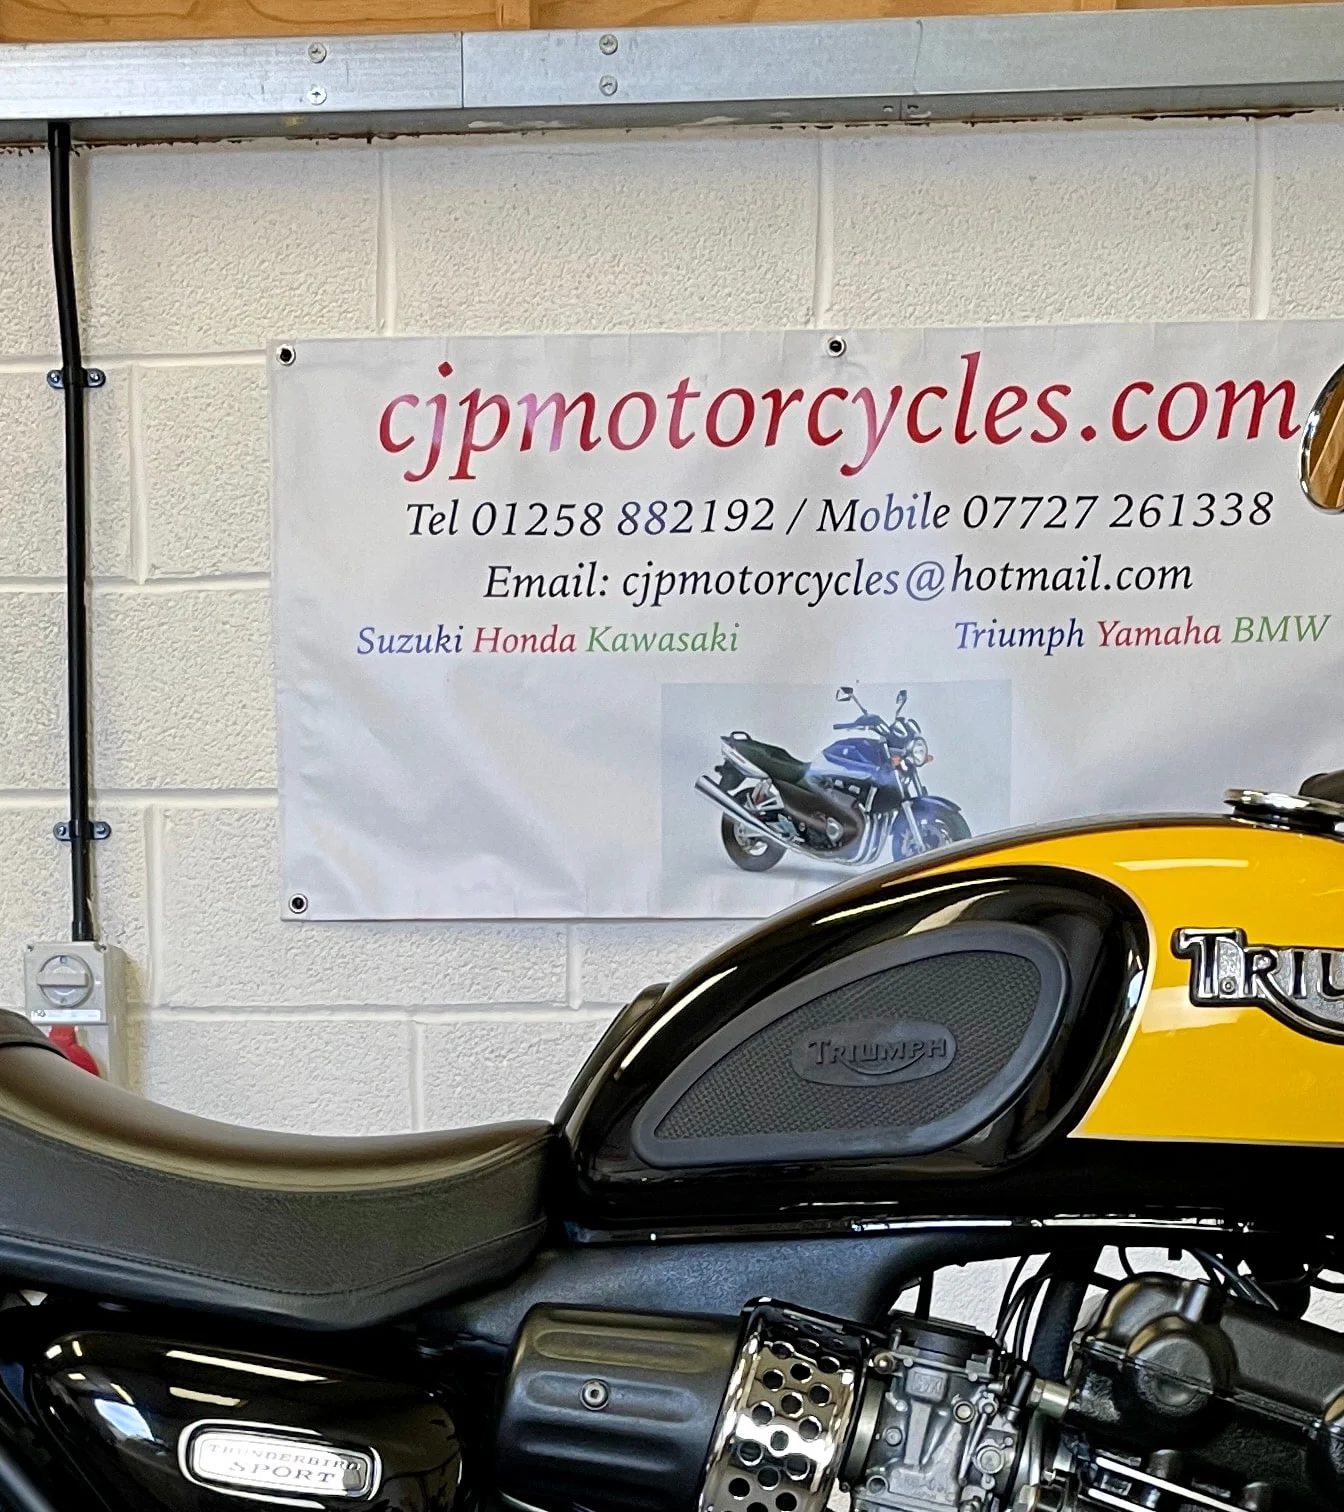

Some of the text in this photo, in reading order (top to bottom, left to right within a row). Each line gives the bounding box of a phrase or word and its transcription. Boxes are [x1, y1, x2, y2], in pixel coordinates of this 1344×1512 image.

[378, 350, 1302, 483] cjpmotorcycles.com
[406, 498, 458, 537] Tel
[471, 500, 605, 537] 01258
[617, 497, 775, 536] 882192
[816, 491, 951, 533] Mobile
[963, 493, 1099, 531] 07727
[1109, 491, 1275, 530] 261338
[483, 553, 1195, 608] Email: cjpmotorcycles@hotmail.com
[357, 622, 739, 655] Suzuki Honda Kawasaki
[955, 614, 1332, 656] Triumph Yamaha BMW
[807, 1037, 948, 1067] TRIUMPH
[229, 1461, 335, 1483] SPORT
